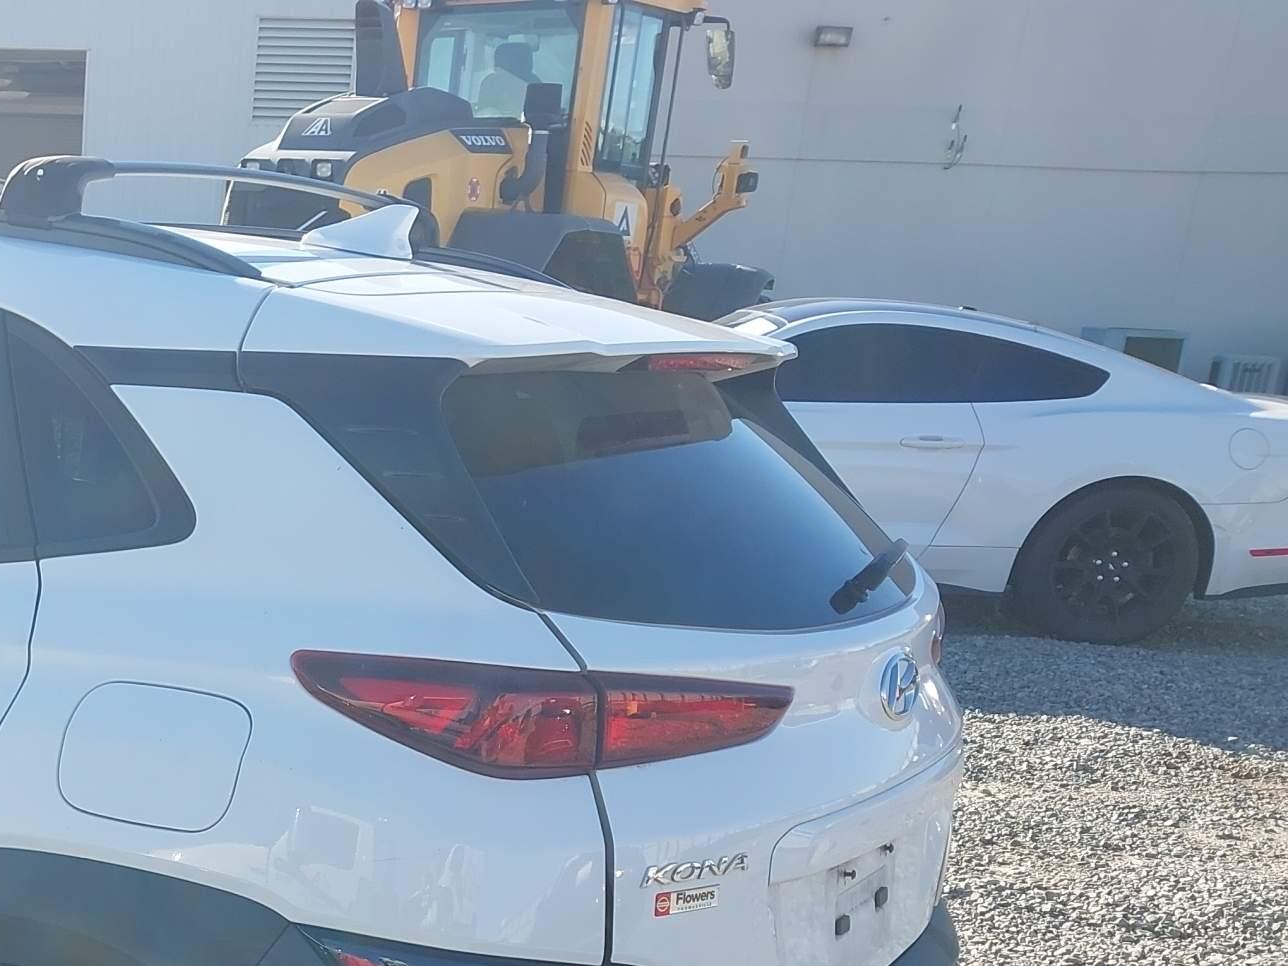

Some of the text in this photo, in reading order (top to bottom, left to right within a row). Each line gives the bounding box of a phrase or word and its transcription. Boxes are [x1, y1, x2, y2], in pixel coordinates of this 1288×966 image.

[459, 135, 505, 146] VOLVO
[639, 852, 749, 888] KONA
[675, 890, 716, 906] Flowers
